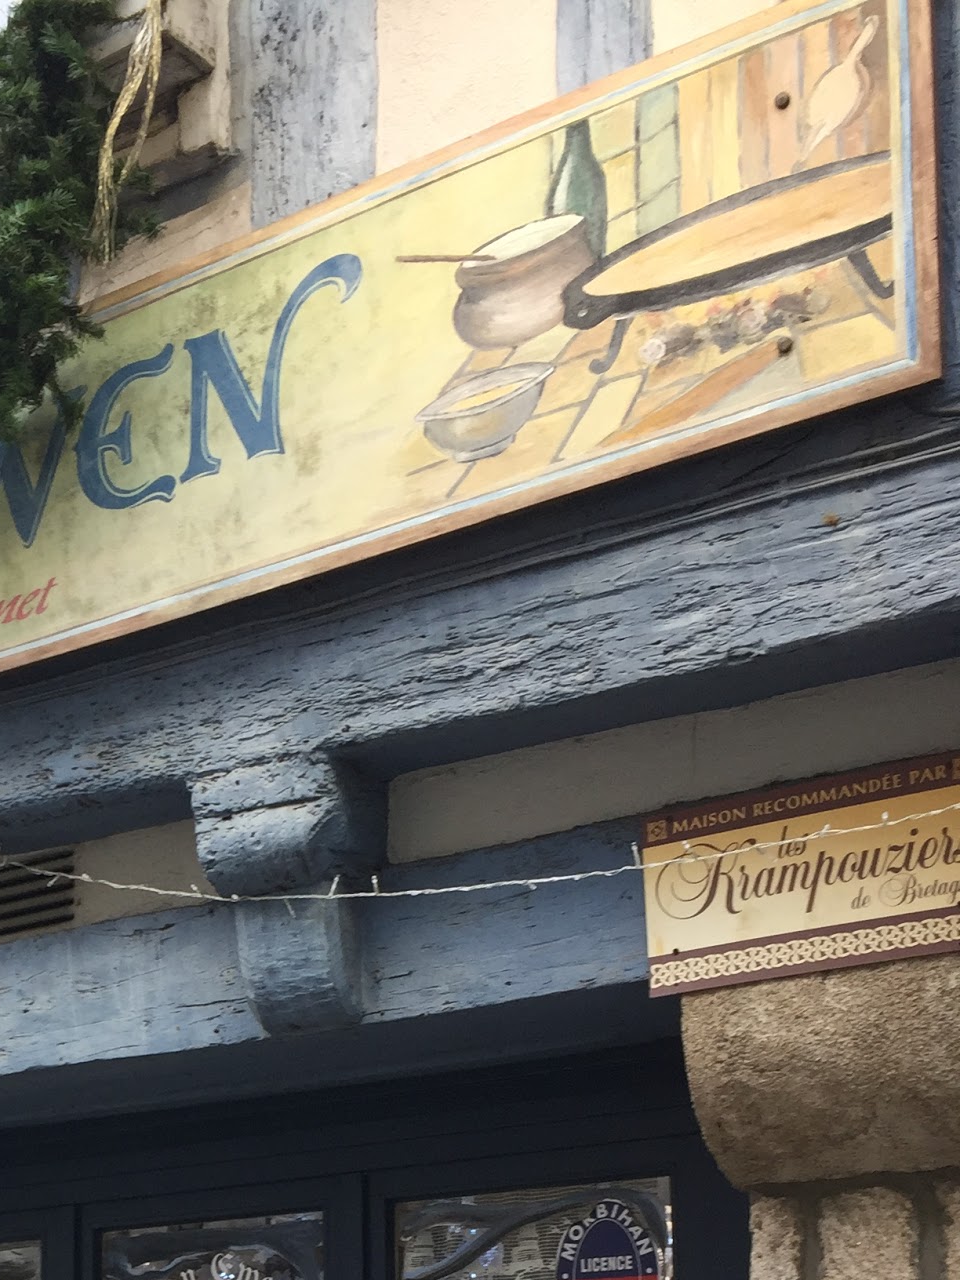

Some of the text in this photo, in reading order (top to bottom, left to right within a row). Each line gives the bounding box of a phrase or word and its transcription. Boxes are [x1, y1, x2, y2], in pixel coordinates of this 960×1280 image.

[672, 764, 947, 834] MAISON RECOMMANDÉE PAR
[851, 886, 872, 910] de
[580, 1255, 633, 1273] LICENCE
